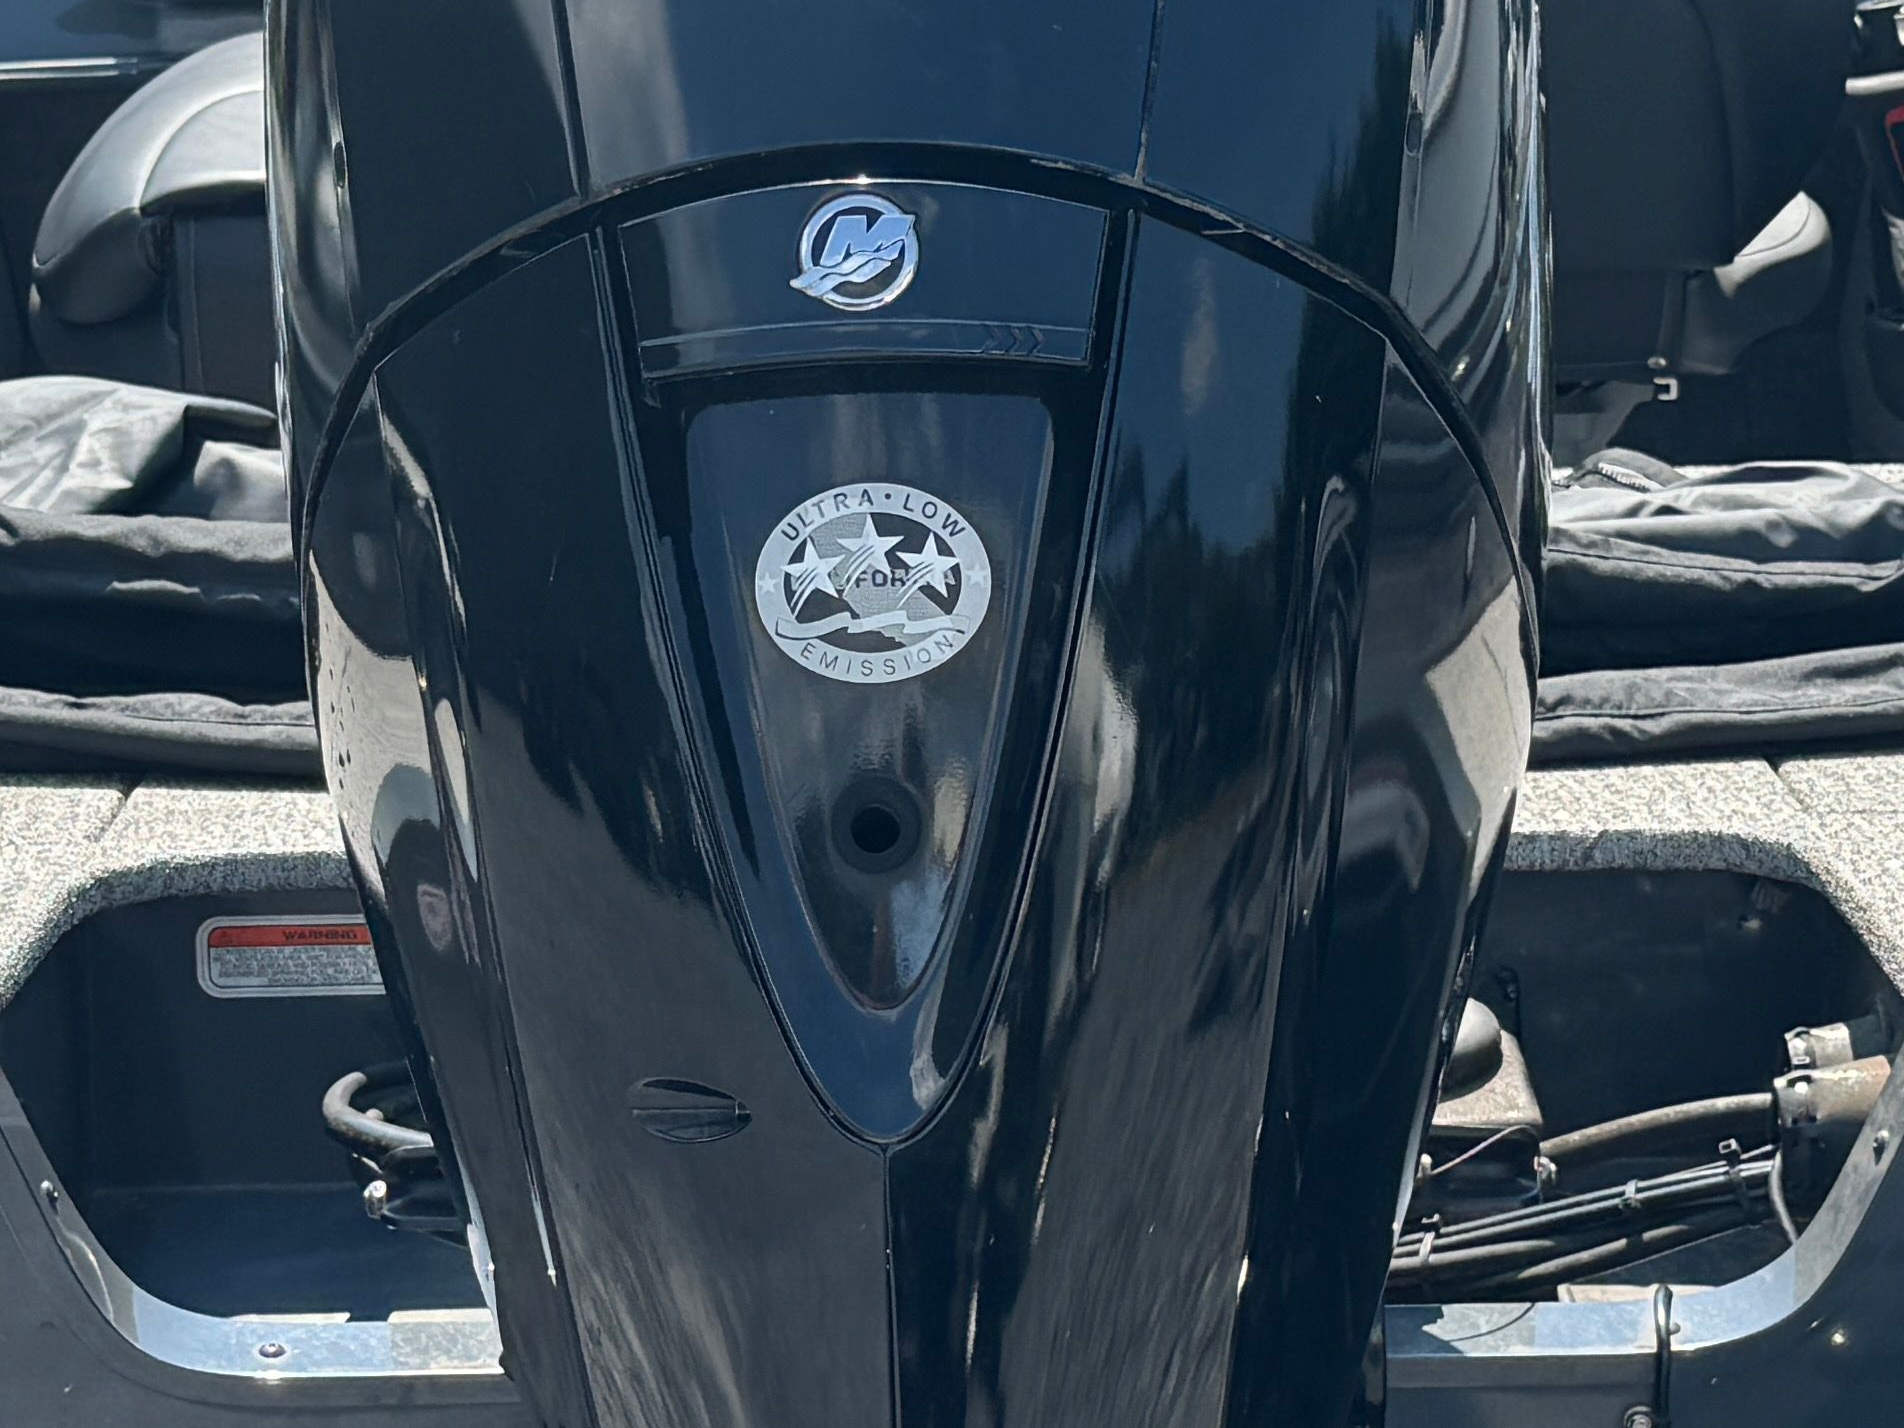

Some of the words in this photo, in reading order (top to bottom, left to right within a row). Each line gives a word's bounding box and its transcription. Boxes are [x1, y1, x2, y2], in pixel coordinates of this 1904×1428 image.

[780, 488, 874, 542] ULTRA
[902, 493, 968, 538] LOW
[799, 633, 954, 677] EMISSION
[283, 929, 358, 941] WARNING
